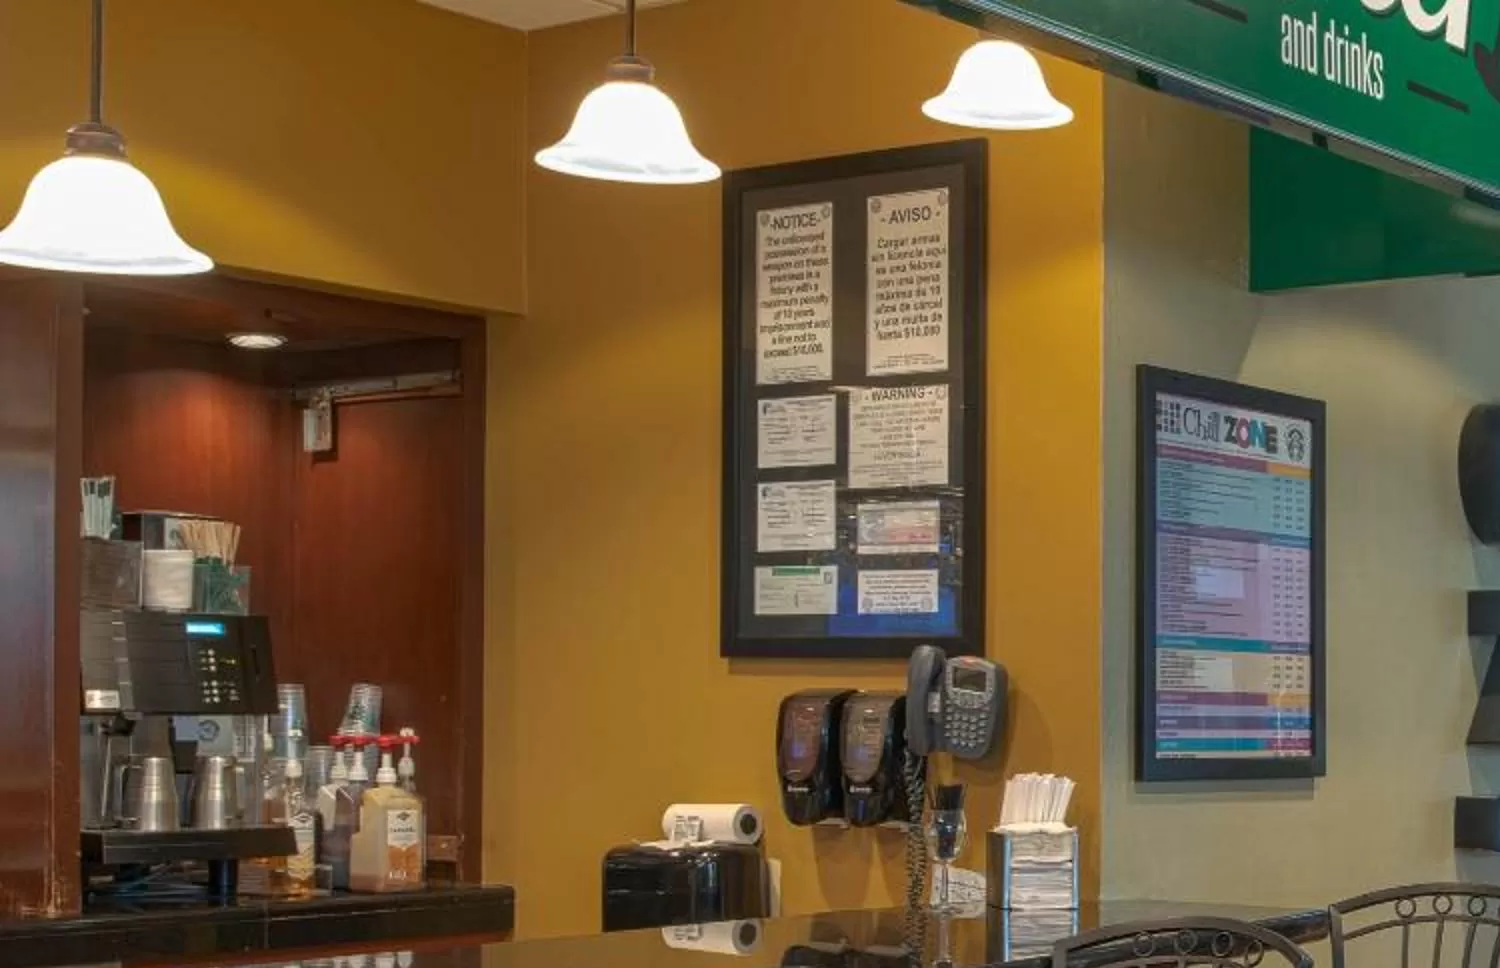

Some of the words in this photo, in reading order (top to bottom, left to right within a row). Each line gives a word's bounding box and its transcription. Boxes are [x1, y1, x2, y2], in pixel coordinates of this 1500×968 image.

[1281, 12, 1318, 75] and
[1323, 19, 1384, 100] drinks
[888, 206, 932, 225] AVISO
[872, 386, 925, 401] WARNING
[1183, 407, 1221, 443] Chill
[1224, 415, 1279, 455] ZONE
